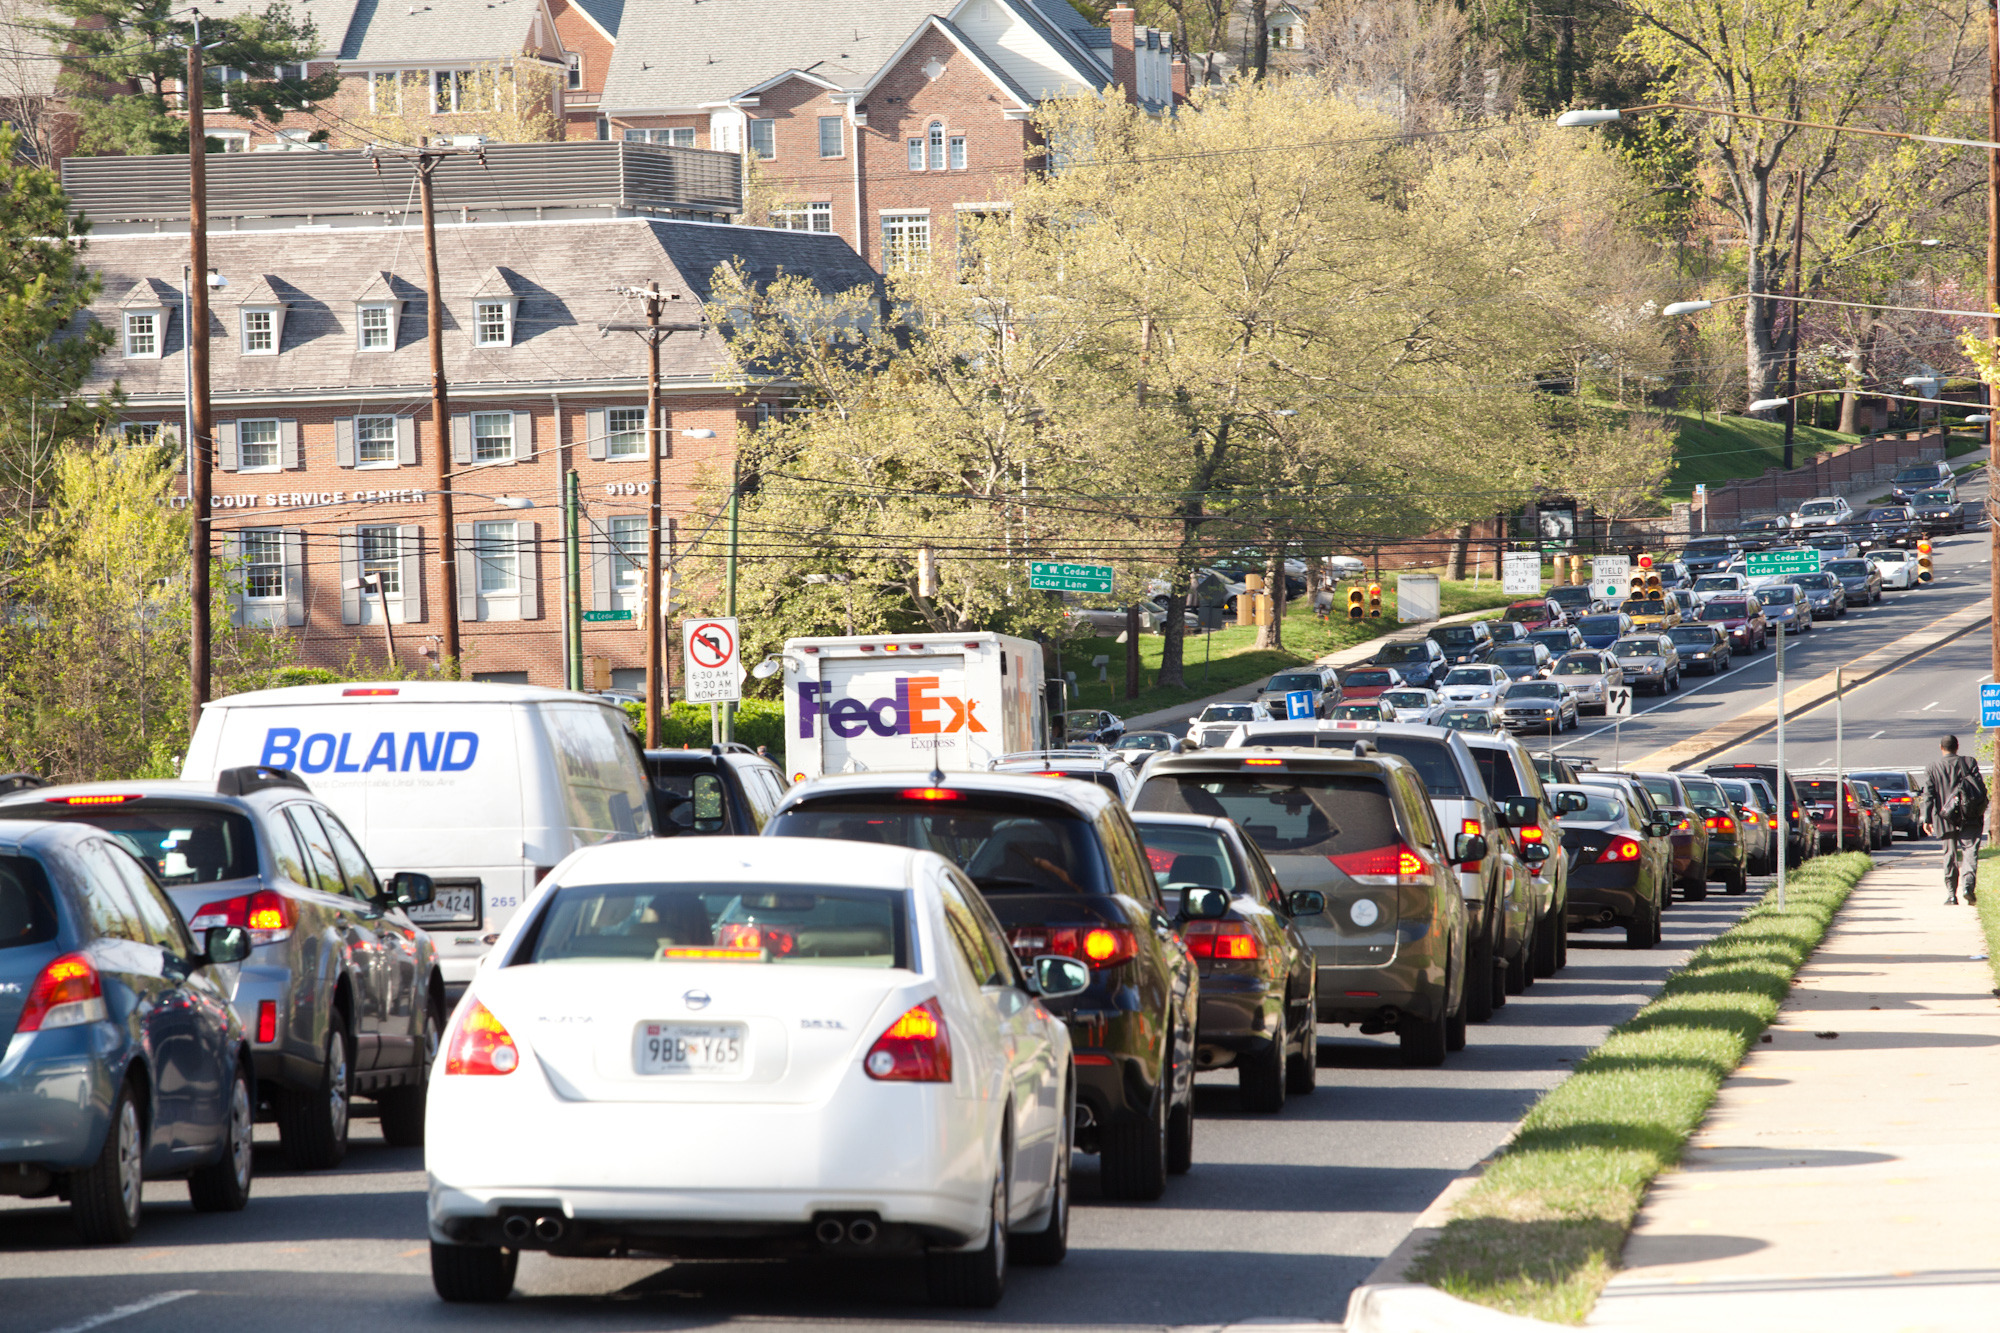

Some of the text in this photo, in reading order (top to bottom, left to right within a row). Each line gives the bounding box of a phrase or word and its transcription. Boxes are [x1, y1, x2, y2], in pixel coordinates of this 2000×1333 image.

[606, 482, 650, 495] 9190
[210, 489, 424, 507] COUT SERVICE CENTER
[1049, 565, 1110, 577] W. Cedar Ln.
[1750, 565, 1800, 574] Cedar Lane
[1033, 578, 1087, 588] Cedar Lane
[597, 612, 614, 620] Cedar
[692, 670, 712, 680] 6:30
[719, 680, 732, 688] AM
[798, 676, 988, 738] FedEx
[1291, 694, 1310, 717] H
[911, 736, 956, 750] Express
[258, 727, 480, 774] BOLAND
[445, 895, 470, 912] 424
[491, 896, 517, 908] 265
[703, 1037, 739, 1062] Y65
